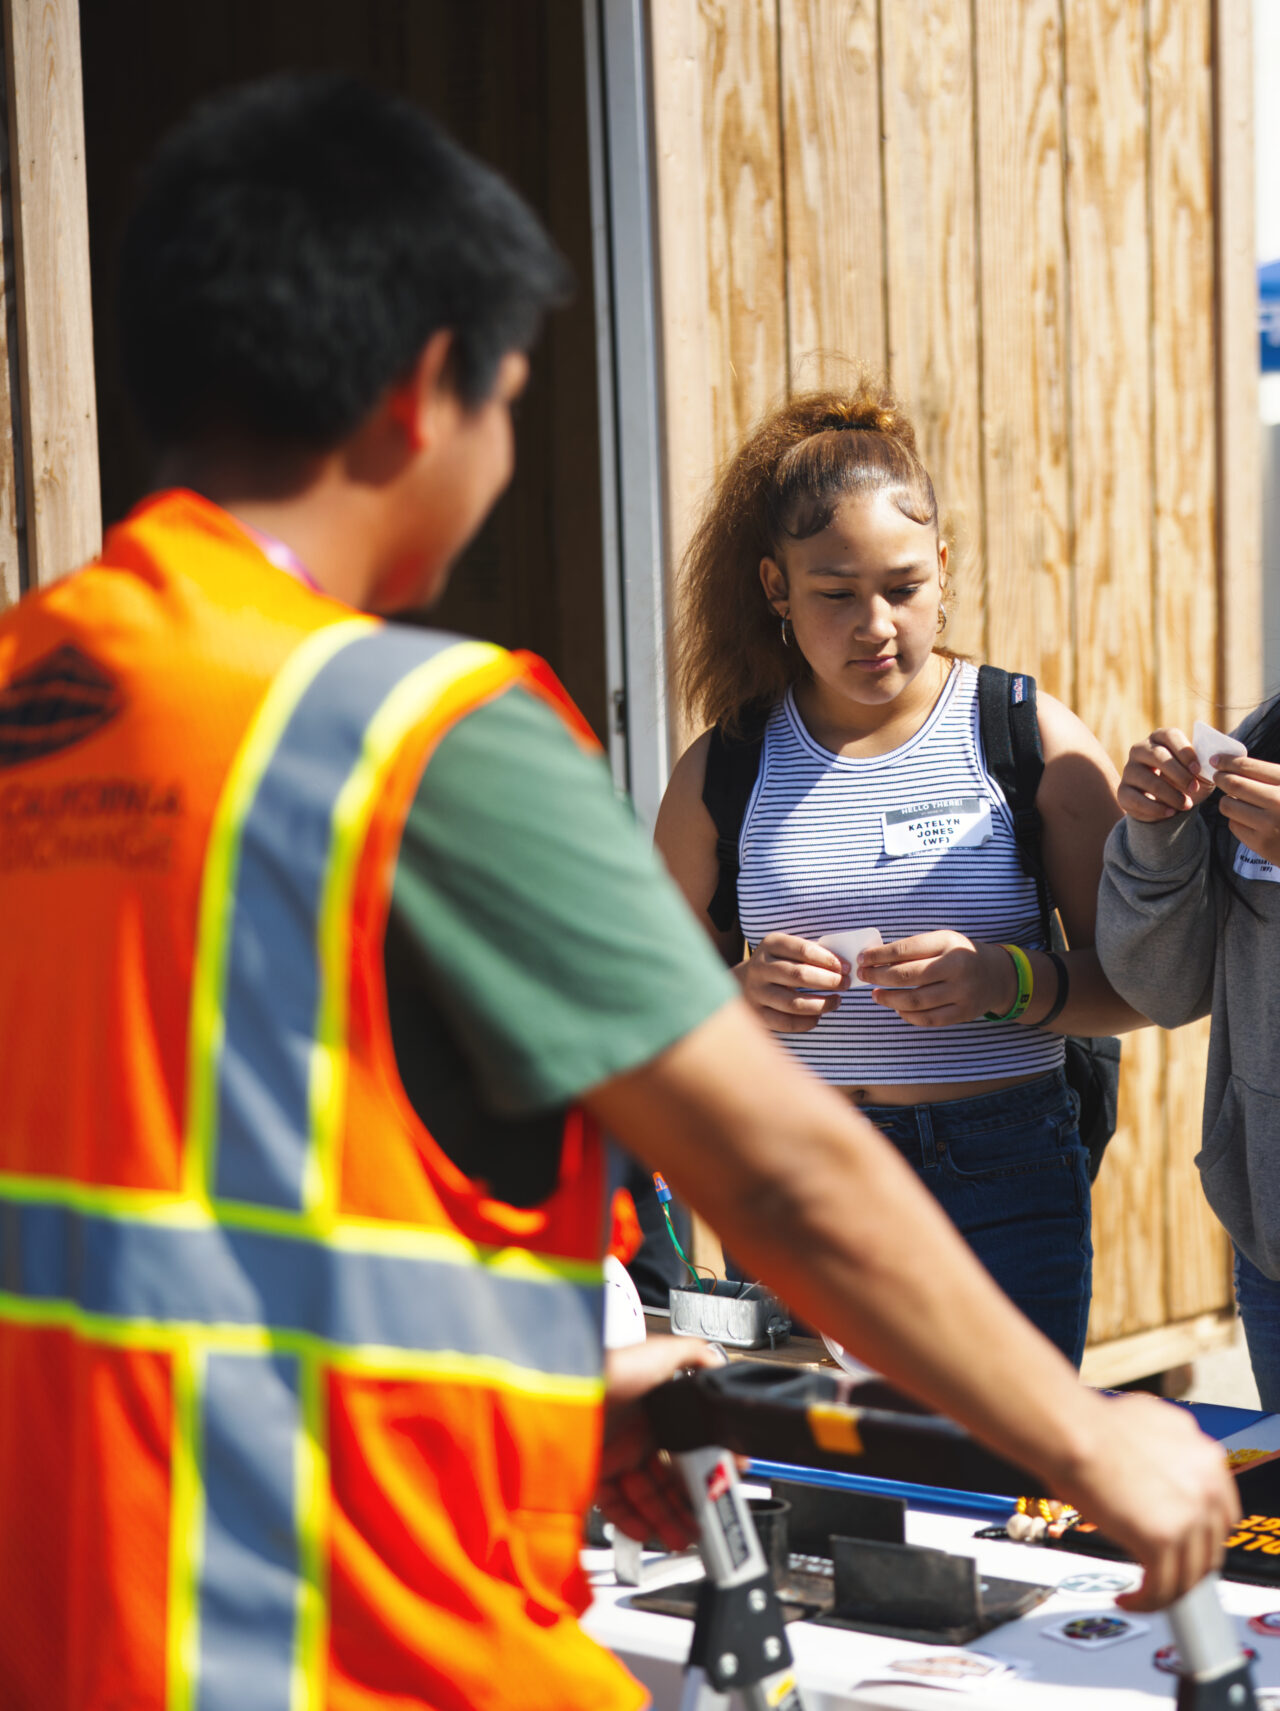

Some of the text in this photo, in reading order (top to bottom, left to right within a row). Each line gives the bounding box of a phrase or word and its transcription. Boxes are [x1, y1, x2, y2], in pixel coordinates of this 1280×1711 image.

[901, 803, 930, 815] HELLO
[909, 818, 960, 831] KATELYN
[917, 827, 954, 838] JONES
[923, 836, 950, 846] (WF)
